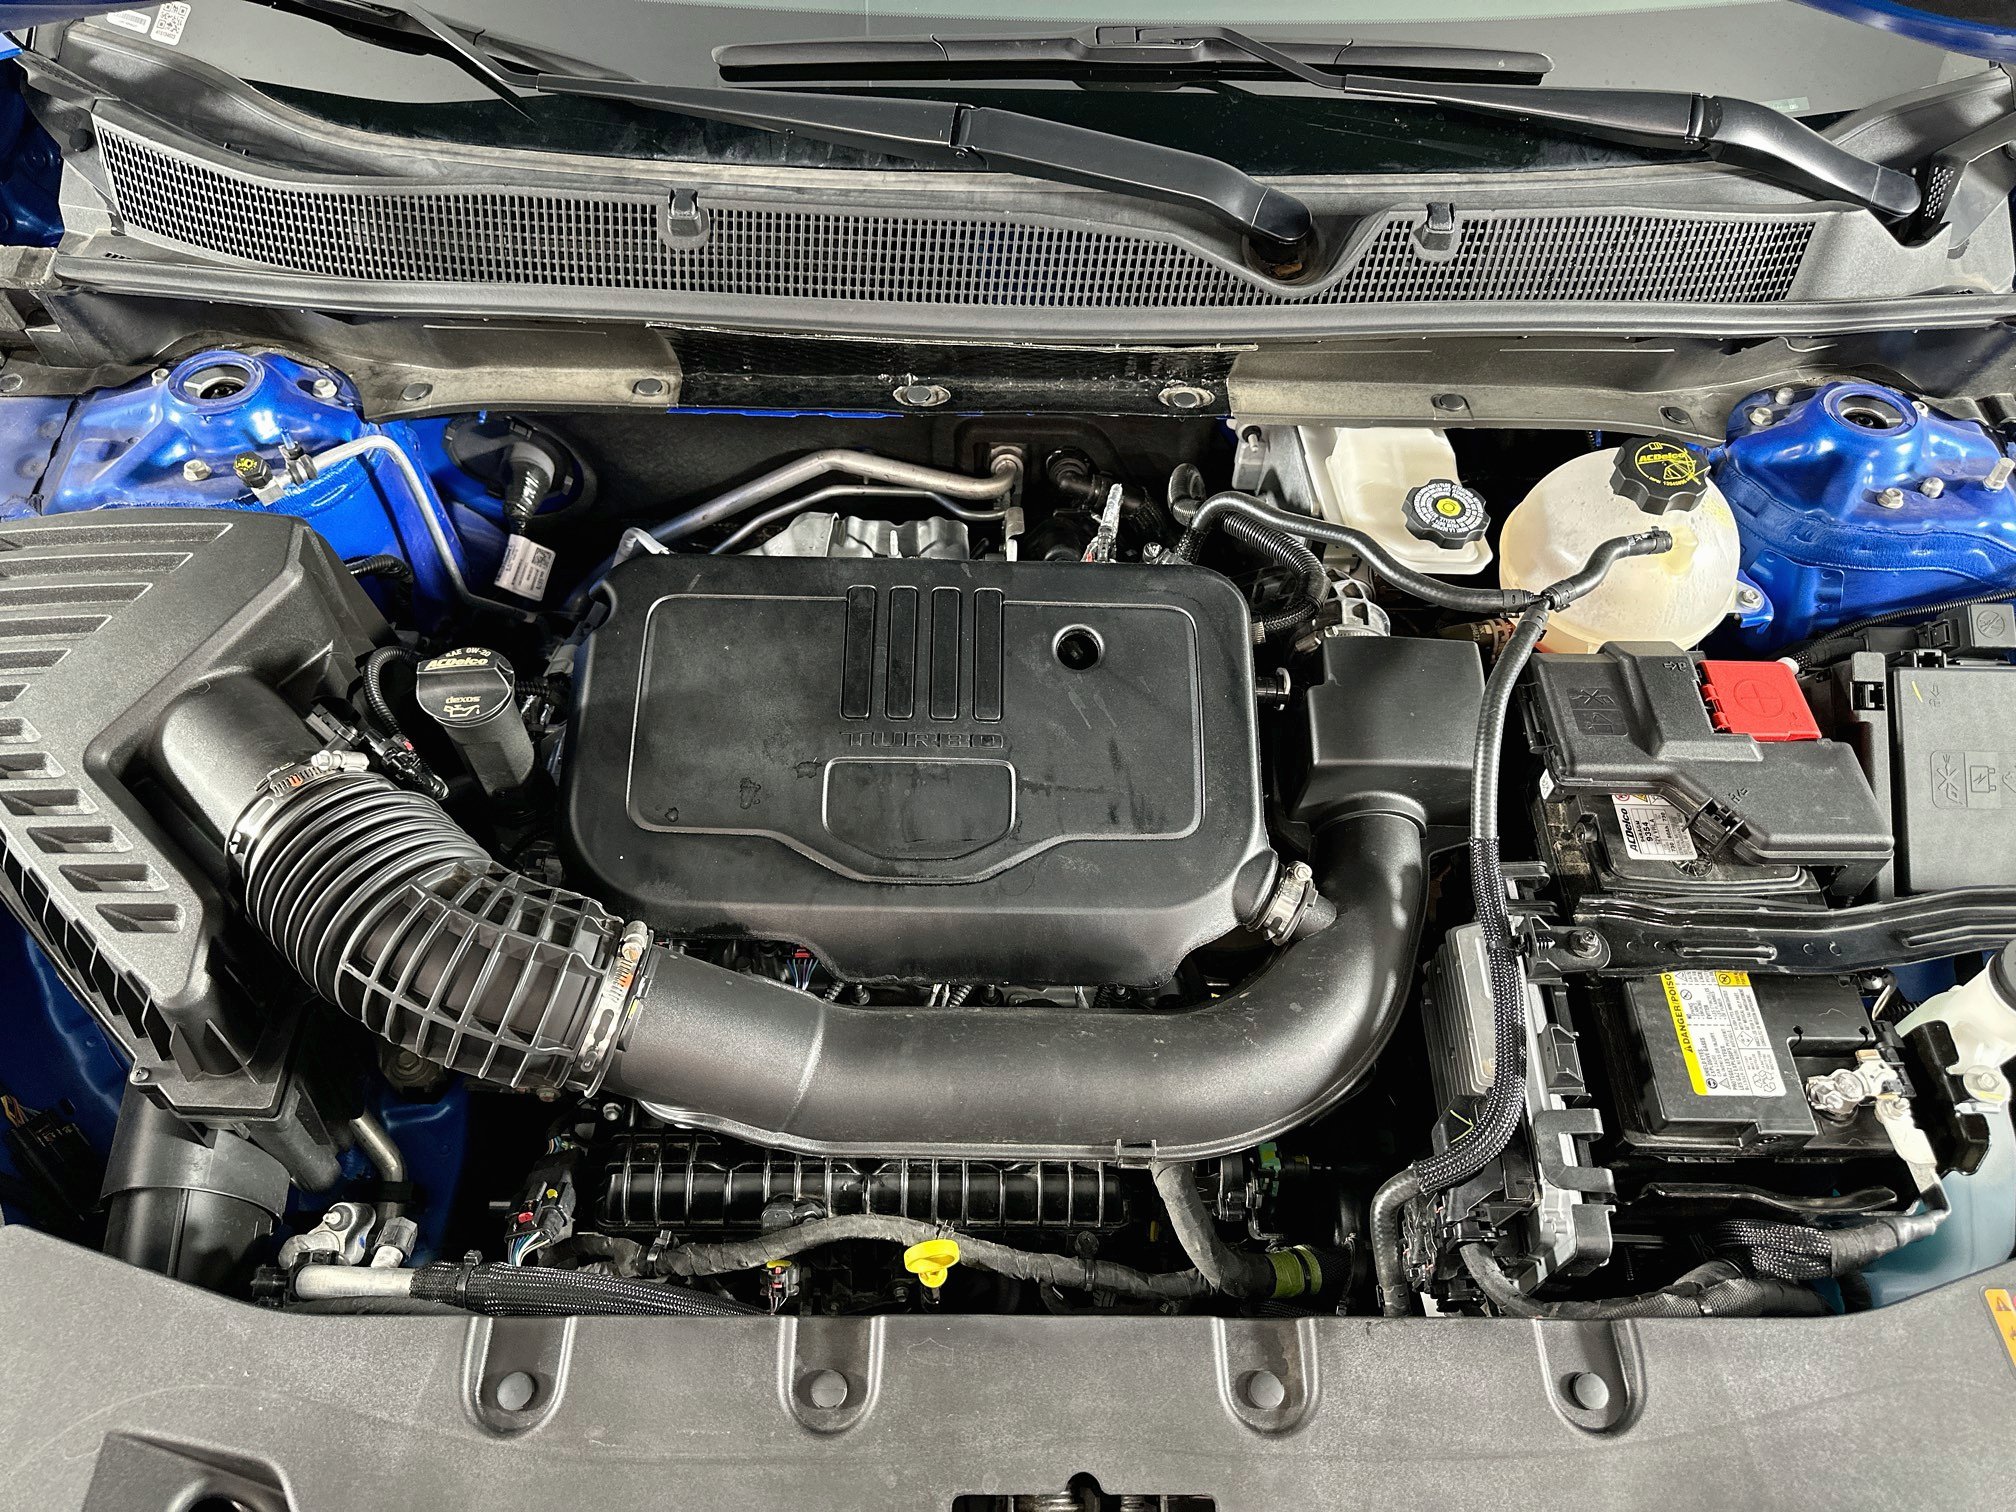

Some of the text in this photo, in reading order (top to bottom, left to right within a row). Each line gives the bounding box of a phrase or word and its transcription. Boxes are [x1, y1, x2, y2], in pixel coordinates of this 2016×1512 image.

[1638, 452, 1685, 463] ACDelco
[466, 647, 491, 657] 0W-20
[427, 657, 488, 669] ACDelco
[446, 696, 481, 704] dexos
[840, 731, 1004, 749] TURBO
[1620, 808, 1638, 851] ACDelco
[1642, 821, 1653, 841] 9354
